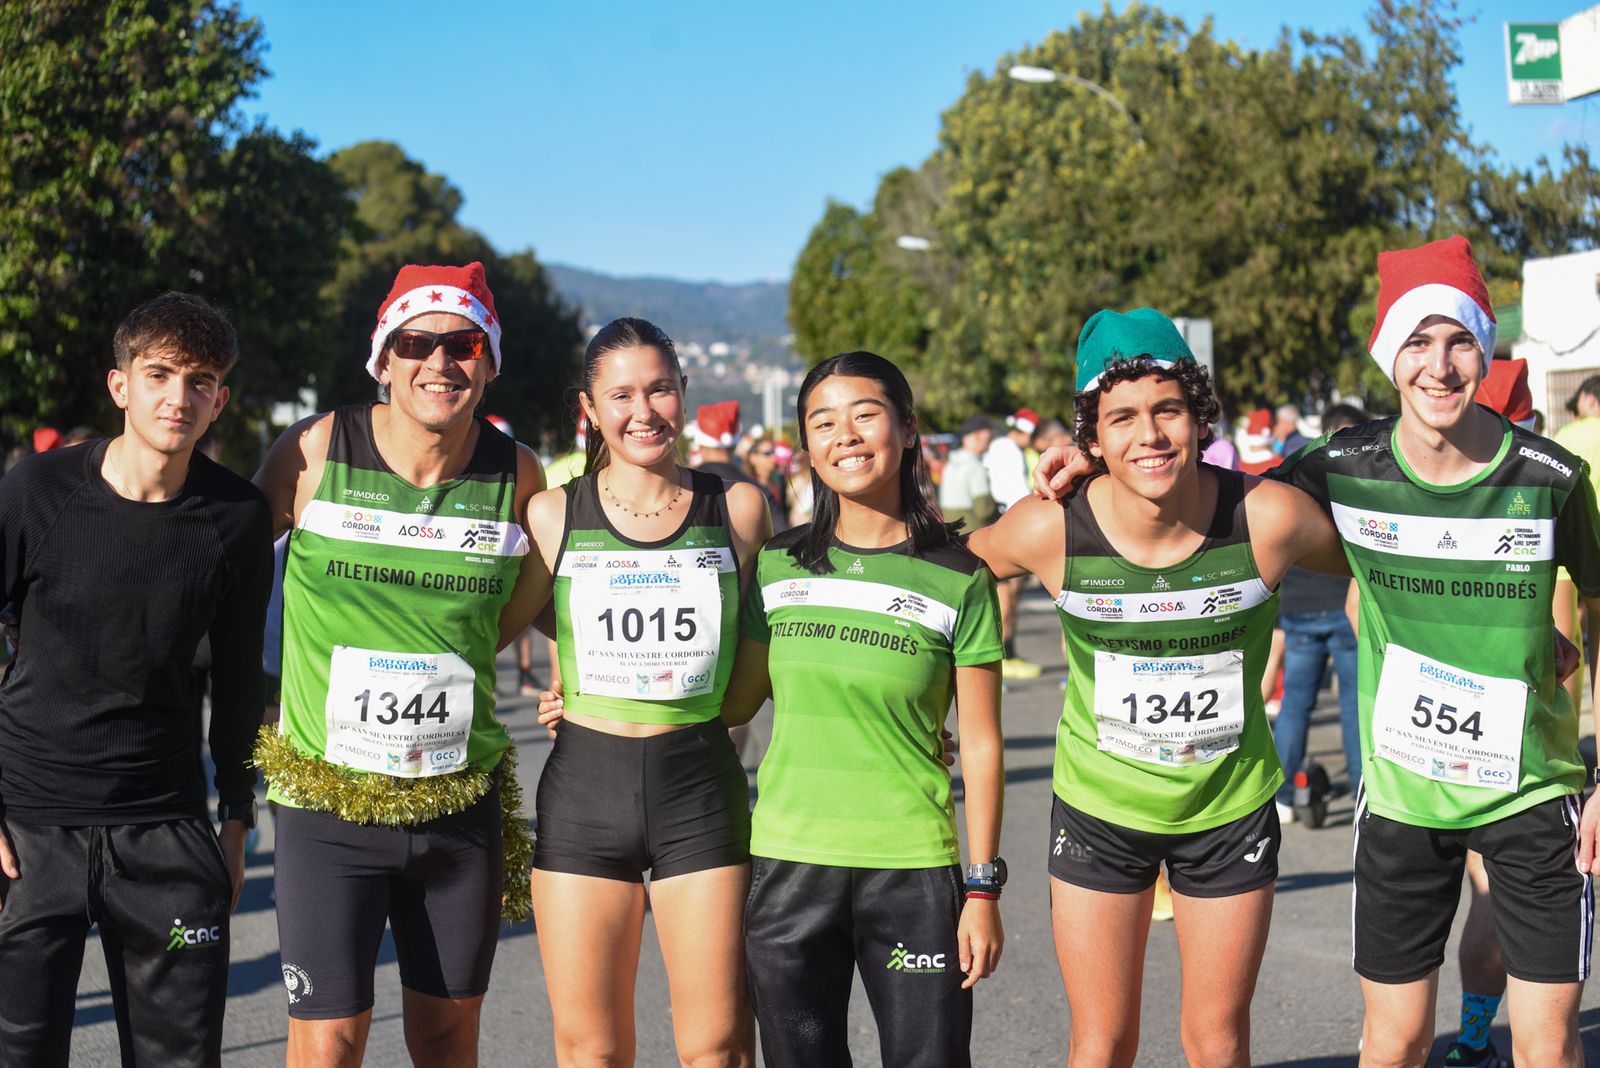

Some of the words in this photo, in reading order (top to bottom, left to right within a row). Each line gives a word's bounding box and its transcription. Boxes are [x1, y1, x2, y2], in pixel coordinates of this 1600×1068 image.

[1341, 448, 1358, 456] LSC
[1519, 446, 1572, 477] DECATHLON
[354, 490, 389, 501] IMDECO
[1507, 504, 1531, 512] AIRE
[342, 521, 381, 532] CÓRDOBA
[398, 524, 443, 539] AOSSA
[1360, 528, 1398, 541] CÓRDOBA
[1506, 564, 1530, 572] PABLO
[326, 560, 415, 586] ATLETISMO
[422, 572, 503, 595] CORDOBÉS
[610, 576, 680, 585] populares
[1203, 572, 1217, 581] LSC
[1369, 568, 1445, 595] ATLETISMO
[1451, 580, 1537, 599] CORDOBÉS
[1087, 605, 1123, 613] CÓRDOBA
[1140, 602, 1183, 613] AOSSA
[598, 607, 697, 642] 1015
[774, 622, 836, 639] ATLETISMO
[840, 626, 919, 656] CORDOBÉS
[1086, 633, 1162, 650] ATLETISMO
[1169, 625, 1247, 650] CORDOBÉS
[665, 650, 716, 659] CORDOBESA
[595, 674, 630, 684] IMDECO
[688, 674, 706, 683] GCC
[354, 689, 450, 725] 1344
[1122, 689, 1219, 725] 1342
[1411, 694, 1484, 742] 554
[352, 727, 368, 735] SAN
[370, 730, 414, 741] SILVESTRE
[417, 730, 466, 741] CORDOBESA
[1140, 731, 1188, 739] SILVESTRE
[1189, 724, 1240, 737] CORDOBESA
[345, 745, 381, 760] IMDECO
[1115, 738, 1153, 753] IMDECO
[1396, 729, 1413, 740] SAN
[1414, 734, 1460, 752] SILVESTRE
[1462, 746, 1516, 762] CORDOBESA
[436, 751, 455, 760] GCC
[1390, 748, 1426, 765] IMDECO
[1484, 769, 1505, 778] GCC
[184, 926, 220, 944] CAC
[903, 954, 945, 968] CAC
